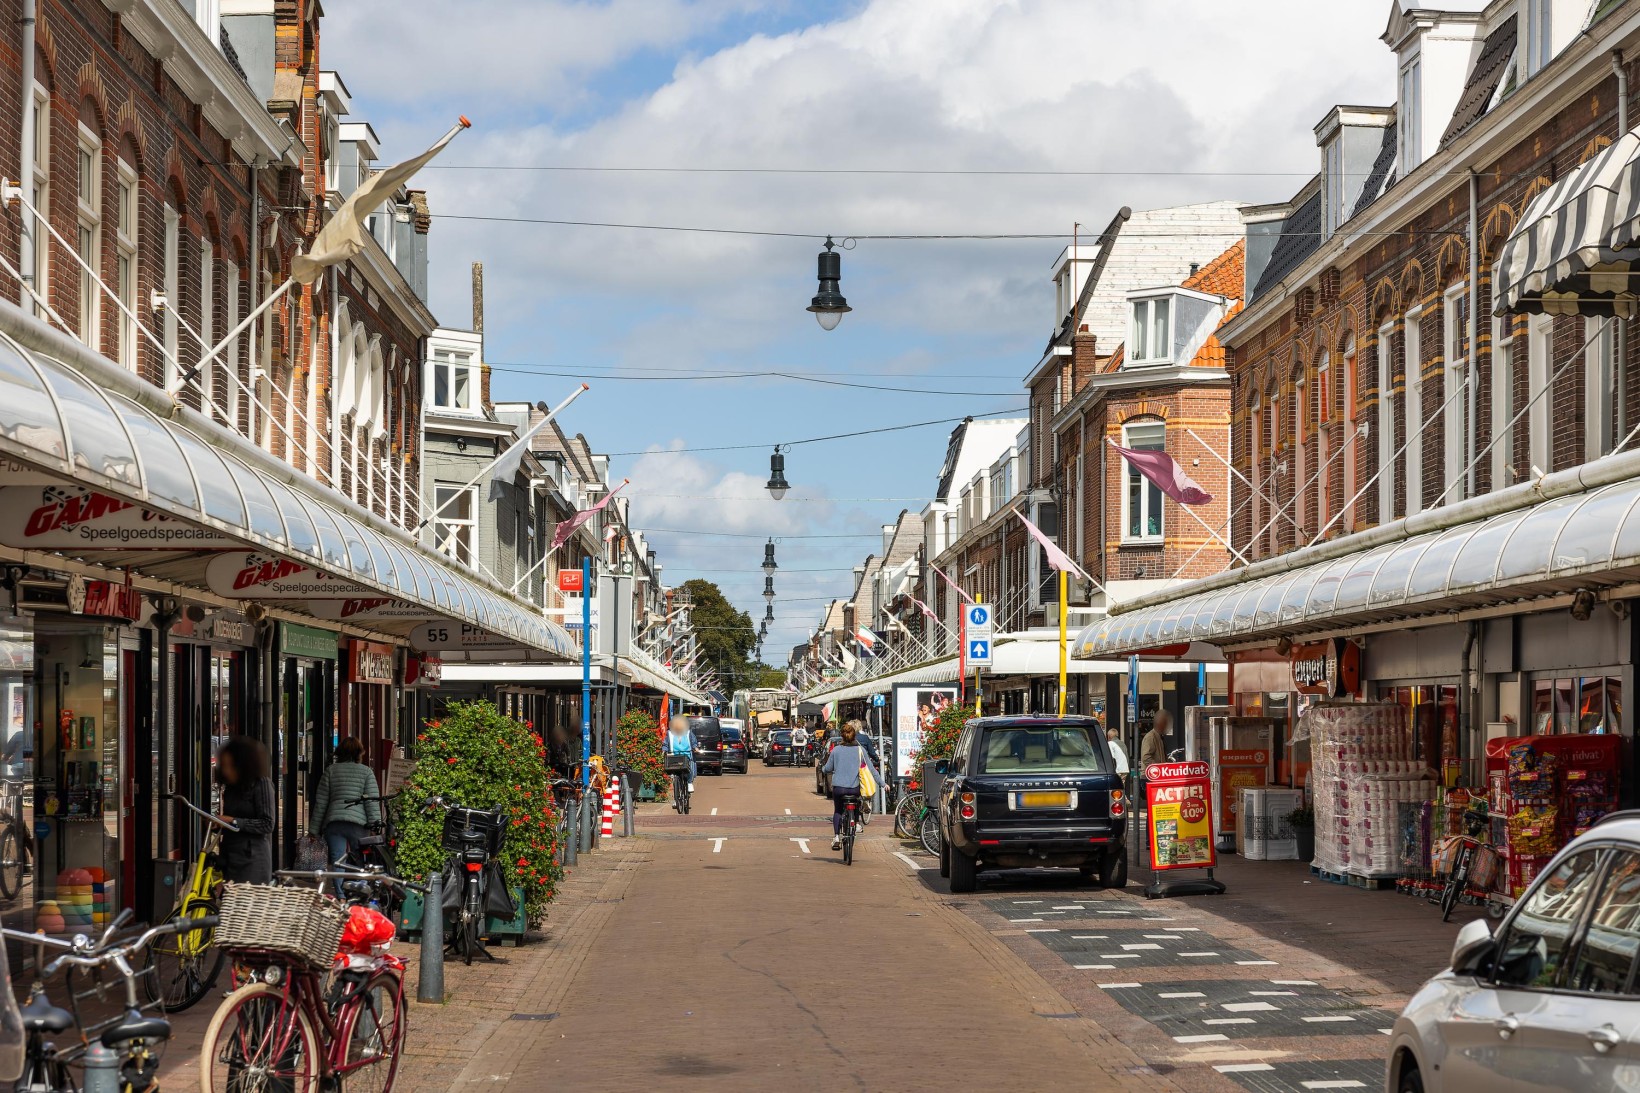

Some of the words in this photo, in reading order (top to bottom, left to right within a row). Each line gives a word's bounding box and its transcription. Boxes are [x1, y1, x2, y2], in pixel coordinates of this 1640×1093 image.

[427, 628, 449, 643] 55
[1294, 654, 1325, 687] expert
[900, 716, 915, 724] ONZE
[900, 732, 907, 741] DE
[1161, 764, 1206, 777] Kruidvat
[1154, 785, 1204, 802] ACTIE!
